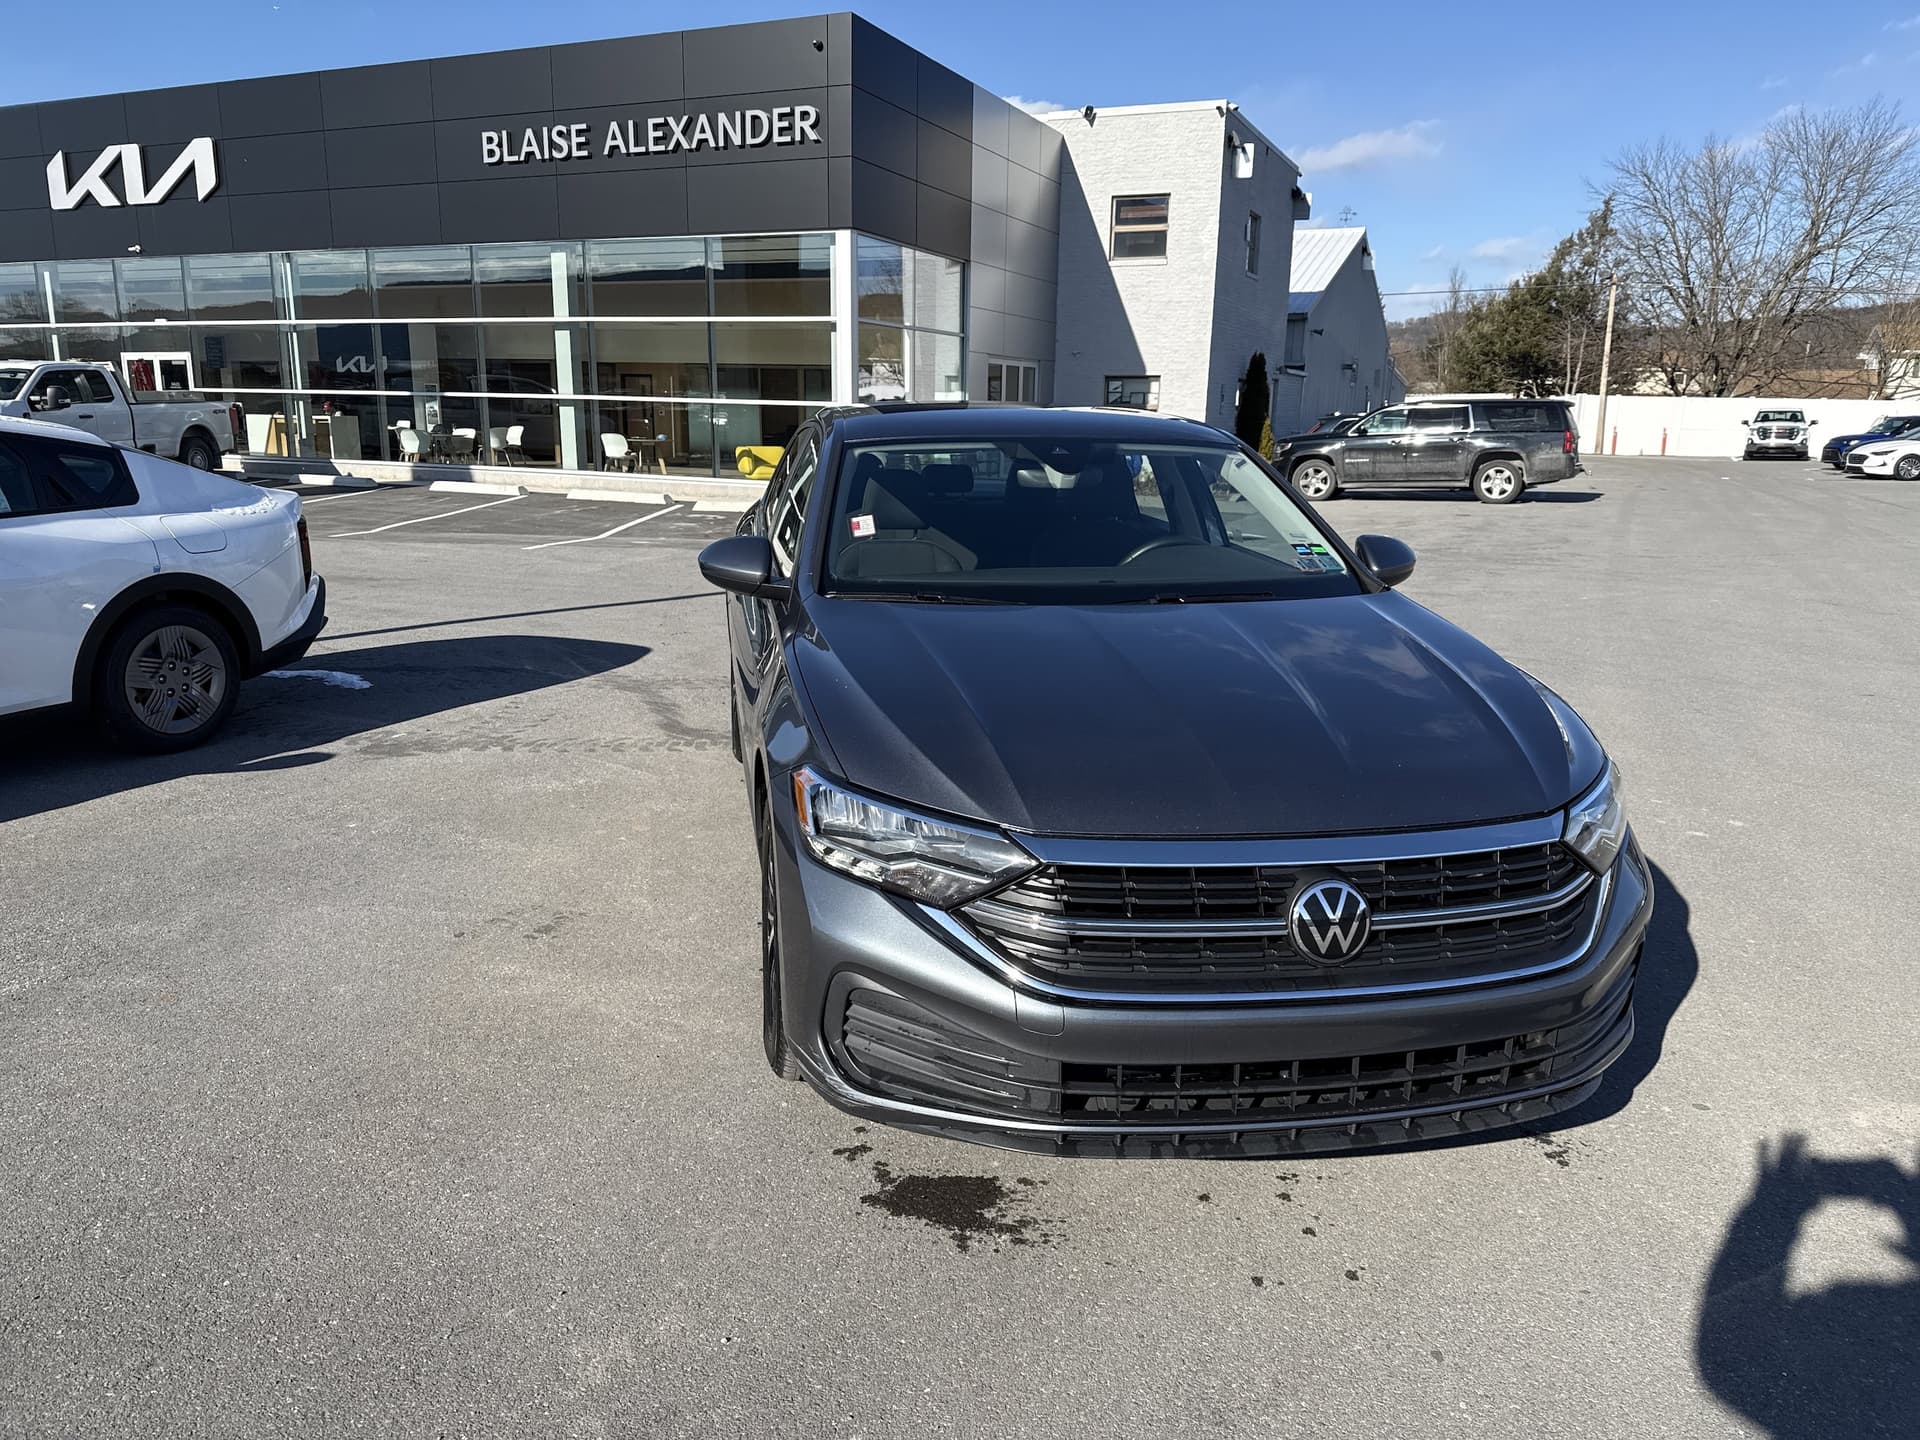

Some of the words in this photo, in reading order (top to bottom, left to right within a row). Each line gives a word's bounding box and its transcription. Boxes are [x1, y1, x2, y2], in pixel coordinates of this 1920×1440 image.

[481, 123, 589, 164] BLAISE
[603, 105, 821, 155] ALEXANDER
[46, 137, 217, 210] KIA
[1294, 882, 1367, 961] VW
